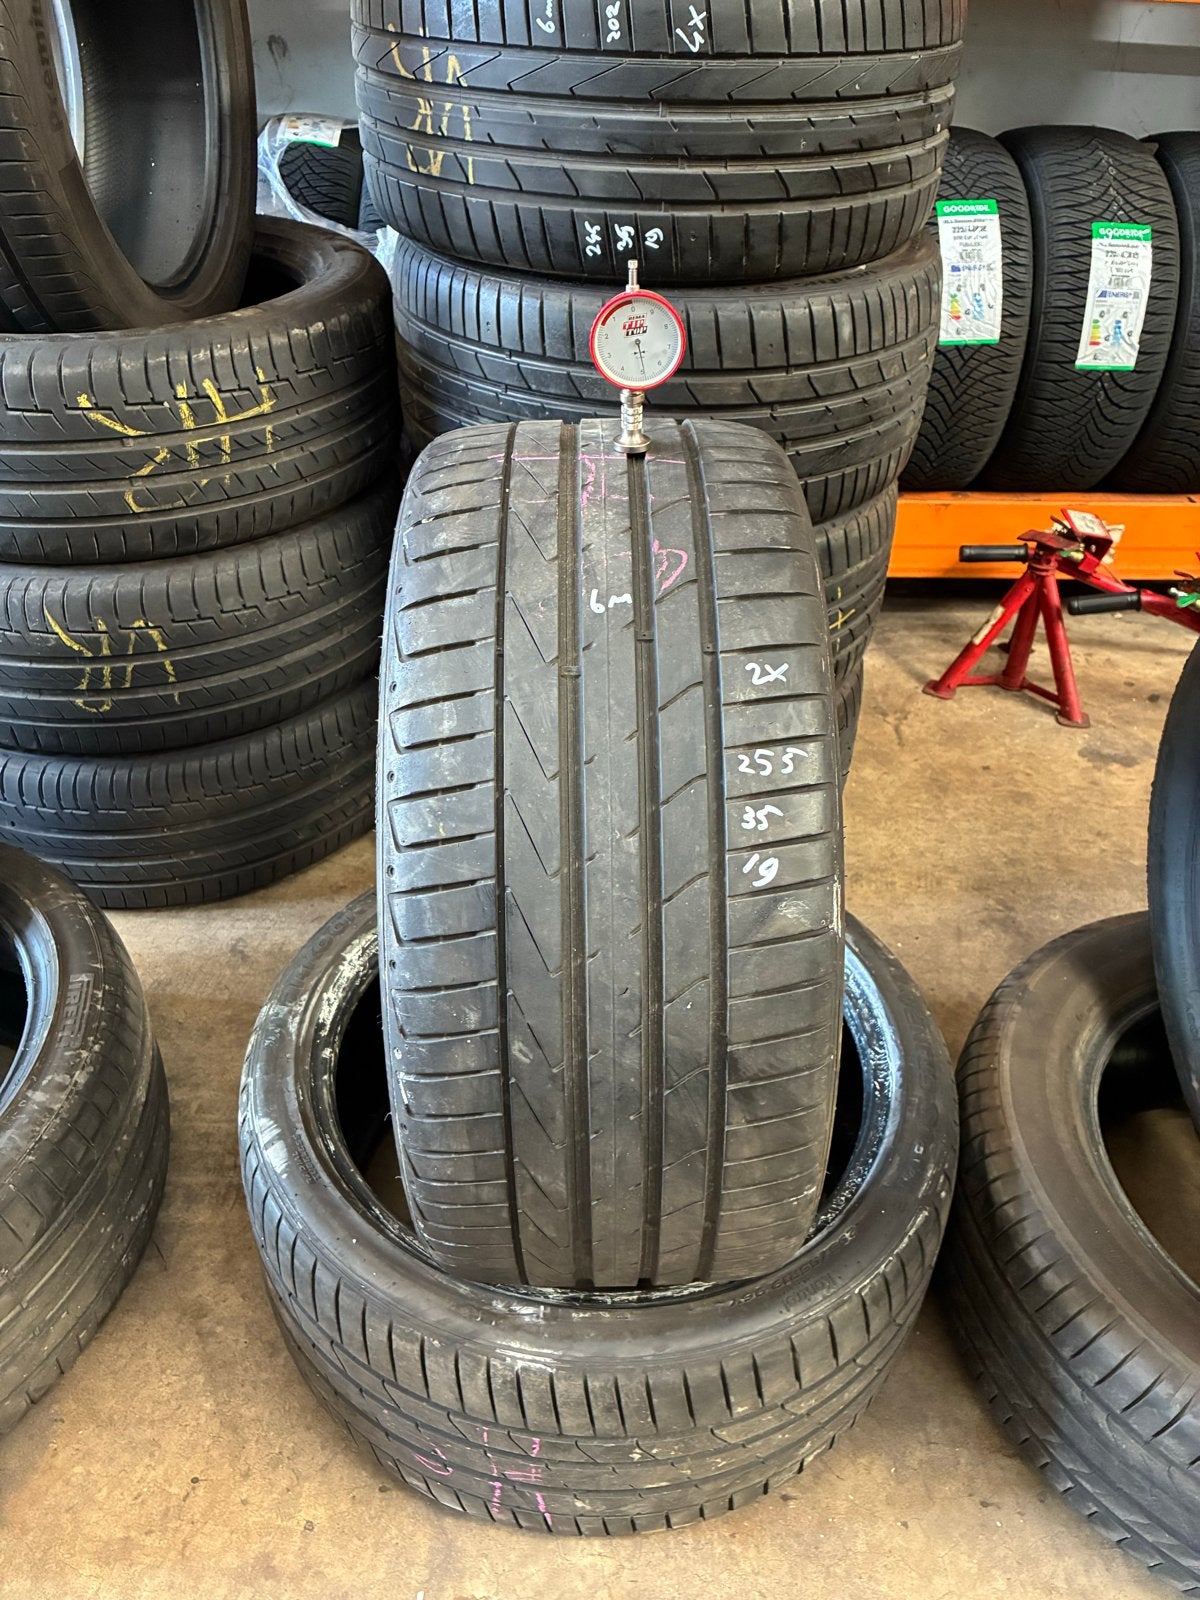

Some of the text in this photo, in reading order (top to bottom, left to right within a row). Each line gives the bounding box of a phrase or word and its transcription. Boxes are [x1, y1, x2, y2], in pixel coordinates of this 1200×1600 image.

[943, 204, 990, 213] GOODRIDE
[737, 747, 809, 776] 255
[741, 804, 784, 831] 35
[742, 853, 780, 888] 19
